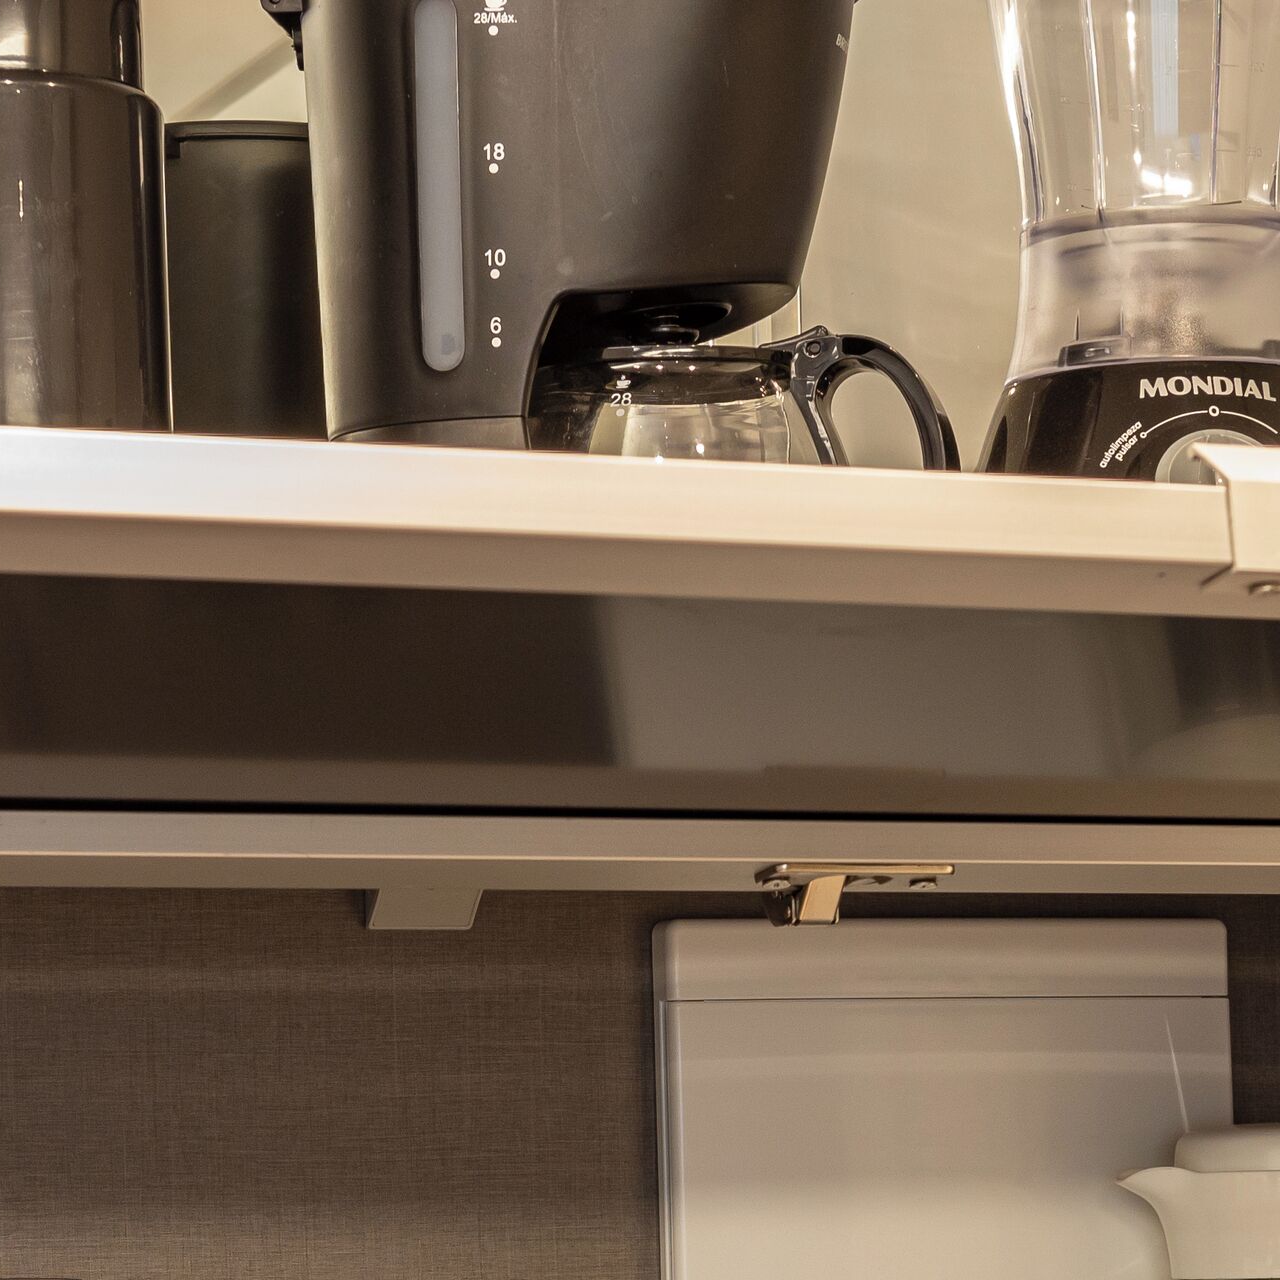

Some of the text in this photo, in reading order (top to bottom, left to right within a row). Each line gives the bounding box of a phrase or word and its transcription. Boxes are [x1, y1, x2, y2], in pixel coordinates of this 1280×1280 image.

[474, 11, 518, 24] 28/Máx.
[483, 143, 505, 161] 18
[484, 249, 506, 267] 10
[490, 317, 502, 334] 6
[1139, 376, 1277, 402] MONDIAL
[610, 392, 632, 407] 28
[1099, 421, 1142, 468] autolimpeza
[1114, 435, 1138, 462] pulsar
